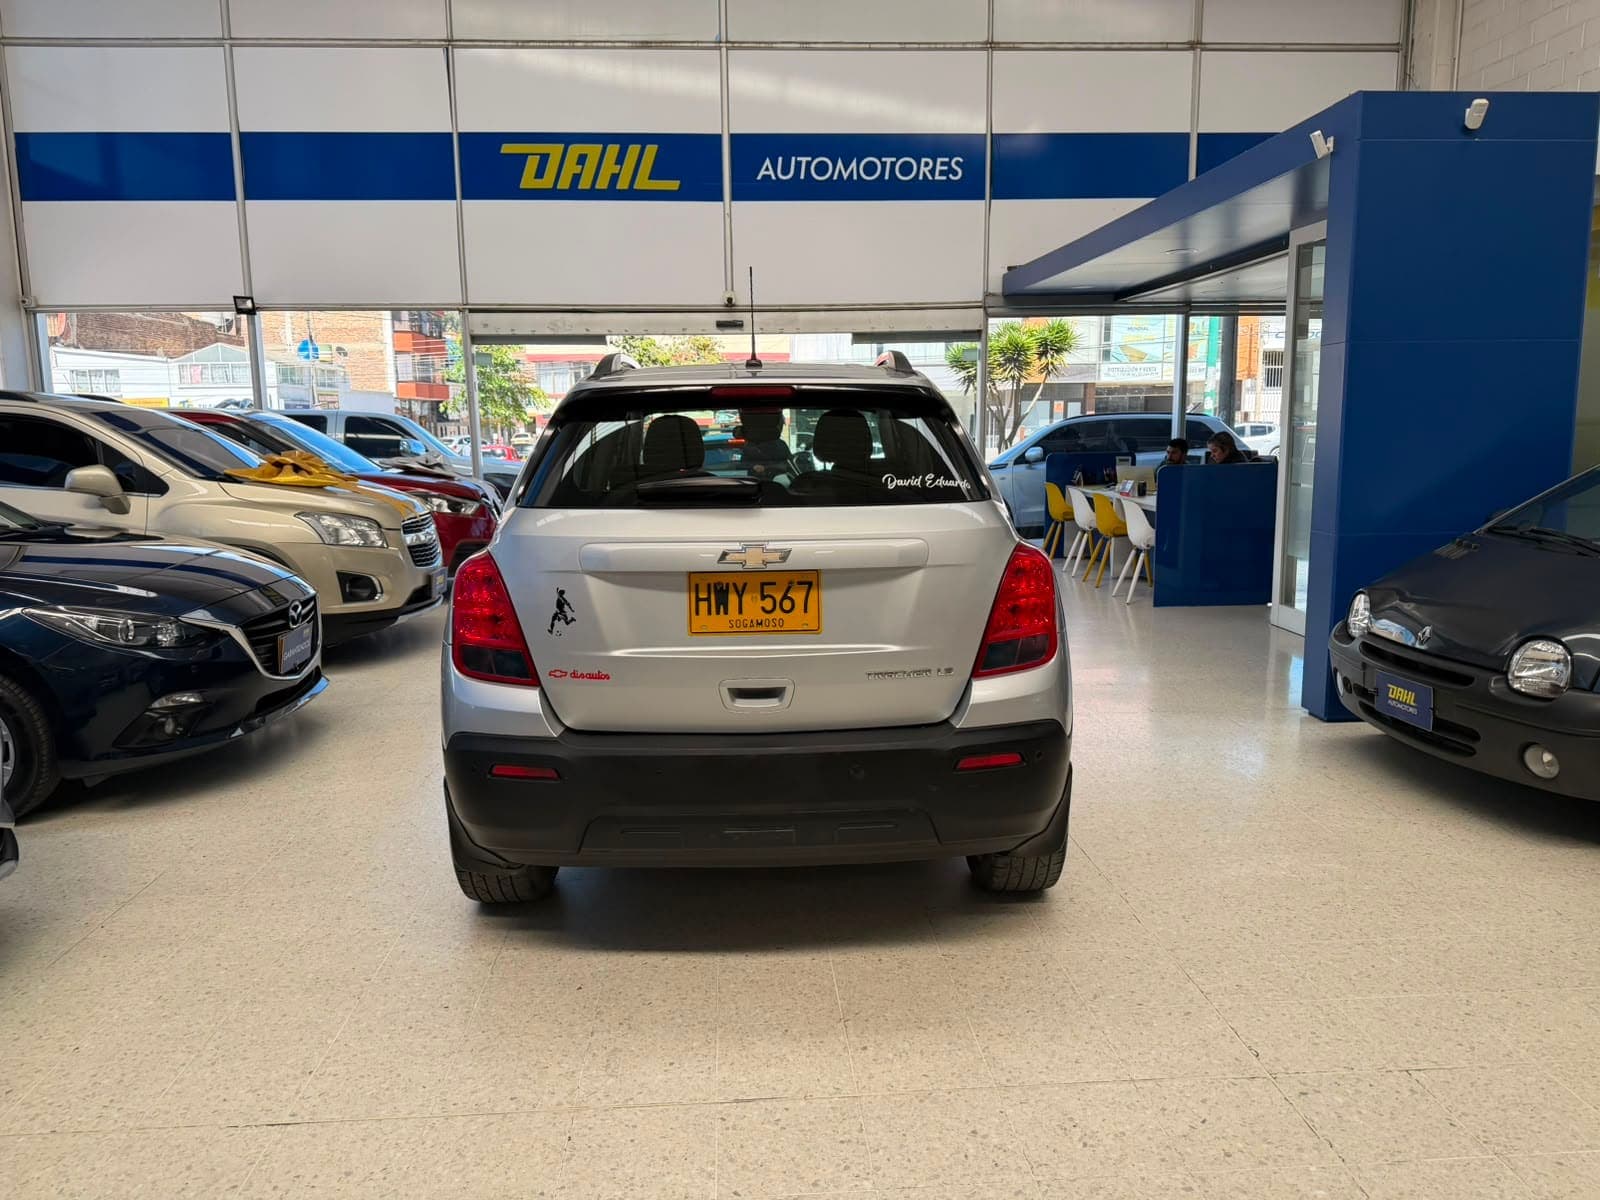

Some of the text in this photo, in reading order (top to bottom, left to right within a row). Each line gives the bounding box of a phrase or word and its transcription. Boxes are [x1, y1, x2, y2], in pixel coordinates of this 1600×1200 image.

[501, 144, 680, 190] DAHL
[756, 156, 964, 181] AUTOMOTORES
[882, 473, 971, 489] David Eduardo
[694, 581, 813, 616] HWY 567
[728, 618, 785, 629] SOGAMOSO
[570, 669, 610, 680] disautos
[1387, 684, 1418, 706] DAHL
